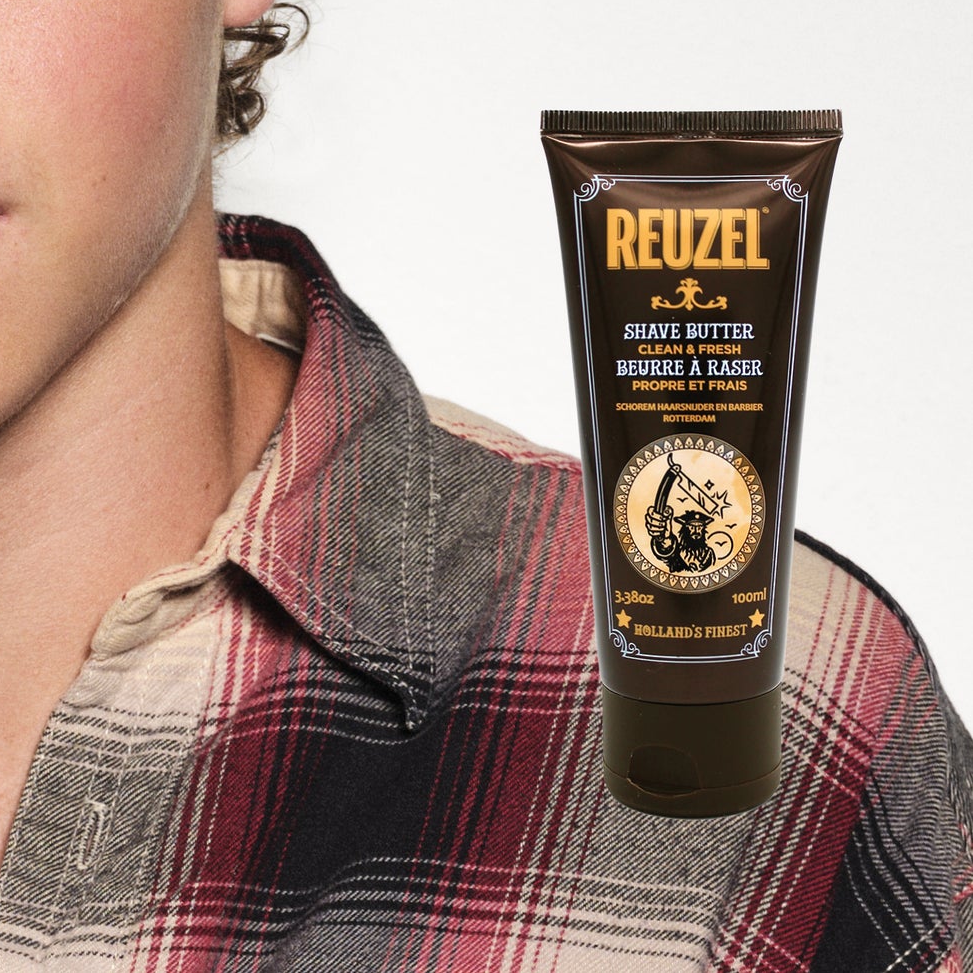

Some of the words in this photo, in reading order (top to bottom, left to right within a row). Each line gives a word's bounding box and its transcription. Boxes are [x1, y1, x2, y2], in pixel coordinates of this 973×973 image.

[624, 323, 680, 340] SHAVE
[685, 323, 755, 340] BUTTER
[638, 344, 682, 355] CLEAN
[686, 344, 695, 355] &
[699, 344, 741, 355] FRESH
[616, 359, 684, 376] BEURRE
[688, 356, 702, 376] À
[707, 359, 763, 376] RASER
[632, 380, 685, 391] PROPRE
[689, 380, 705, 391] ET
[709, 380, 747, 391] FRAIS
[616, 403, 656, 411] SCHOREM
[716, 403, 727, 411] EN
[728, 403, 763, 411] BARBIER
[663, 414, 716, 422] ROTTERDAM
[615, 590, 655, 605] 3.38oz
[732, 587, 767, 604] 100ml
[634, 623, 703, 638] HOLLAND'S
[705, 624, 748, 638] FINEST
